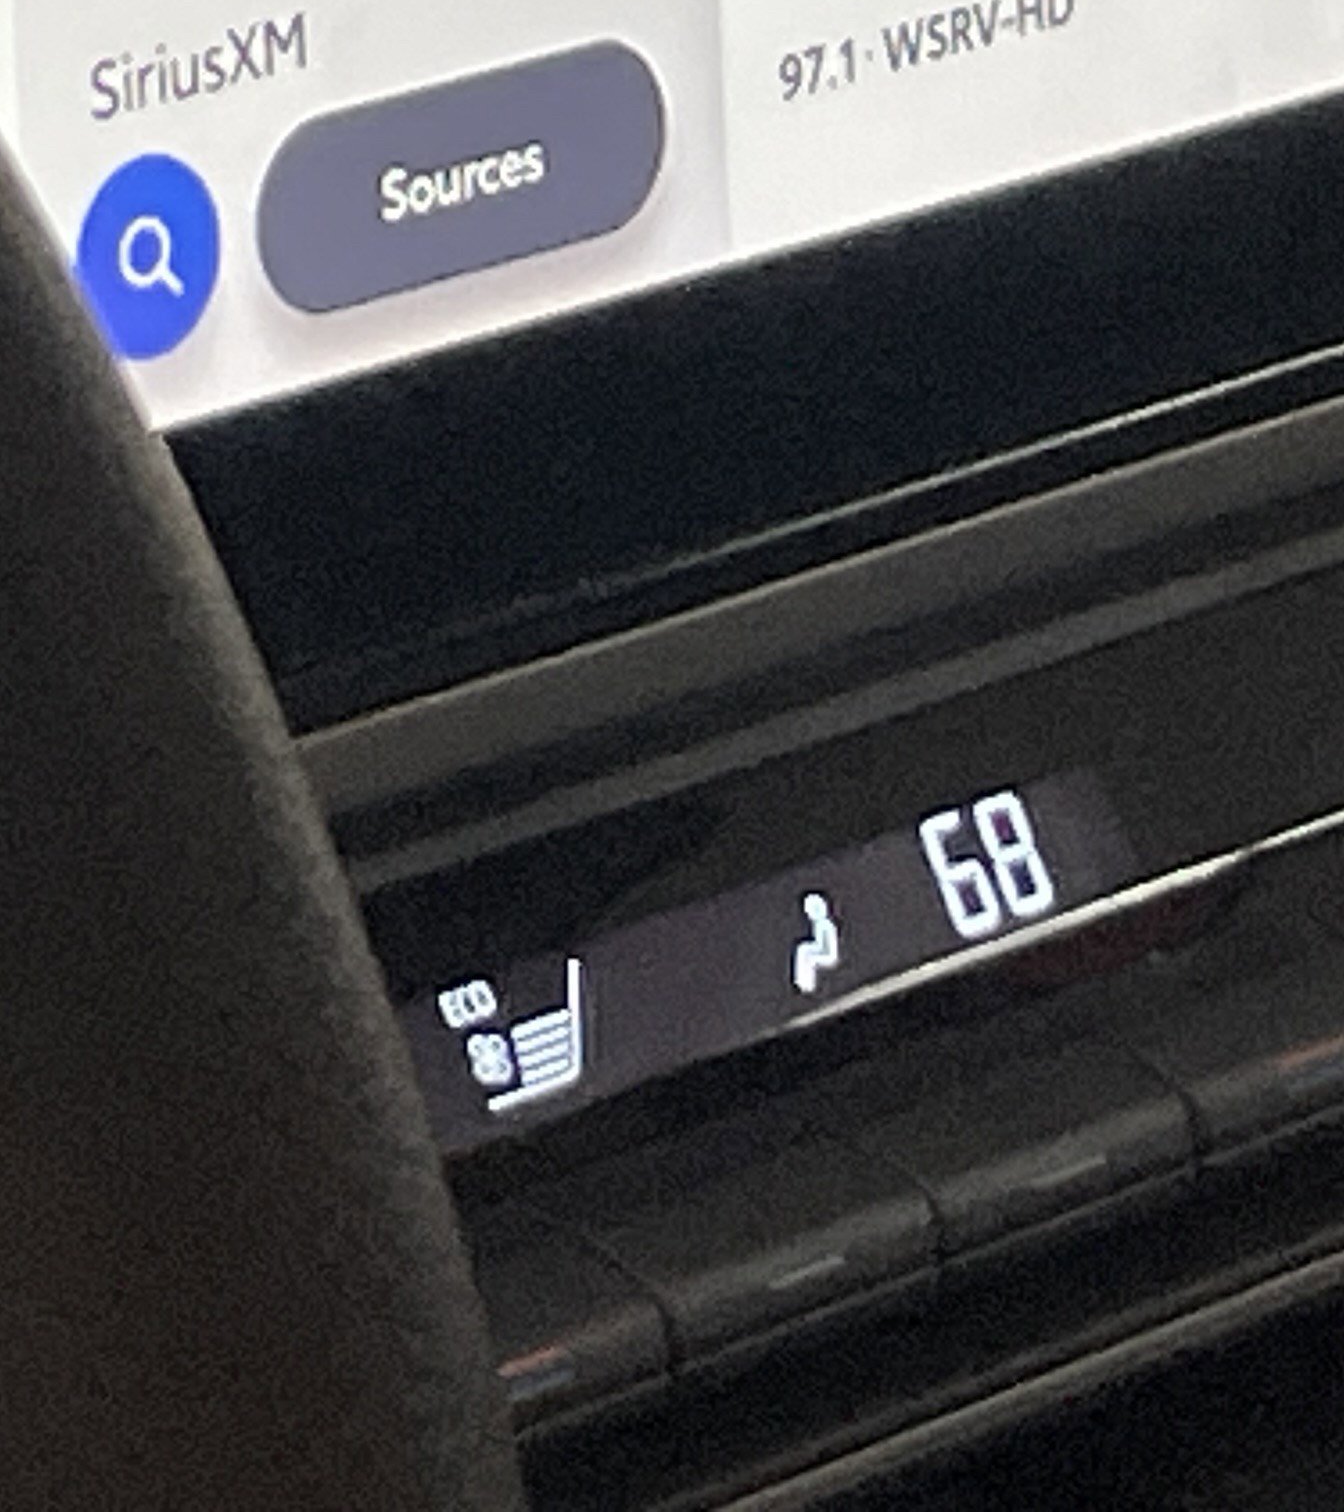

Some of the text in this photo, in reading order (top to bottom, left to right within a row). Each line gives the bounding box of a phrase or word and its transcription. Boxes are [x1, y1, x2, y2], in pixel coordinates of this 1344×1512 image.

[90, 13, 309, 120] SiriusXM
[380, 139, 544, 222] Sources
[918, 790, 1055, 940] 68
